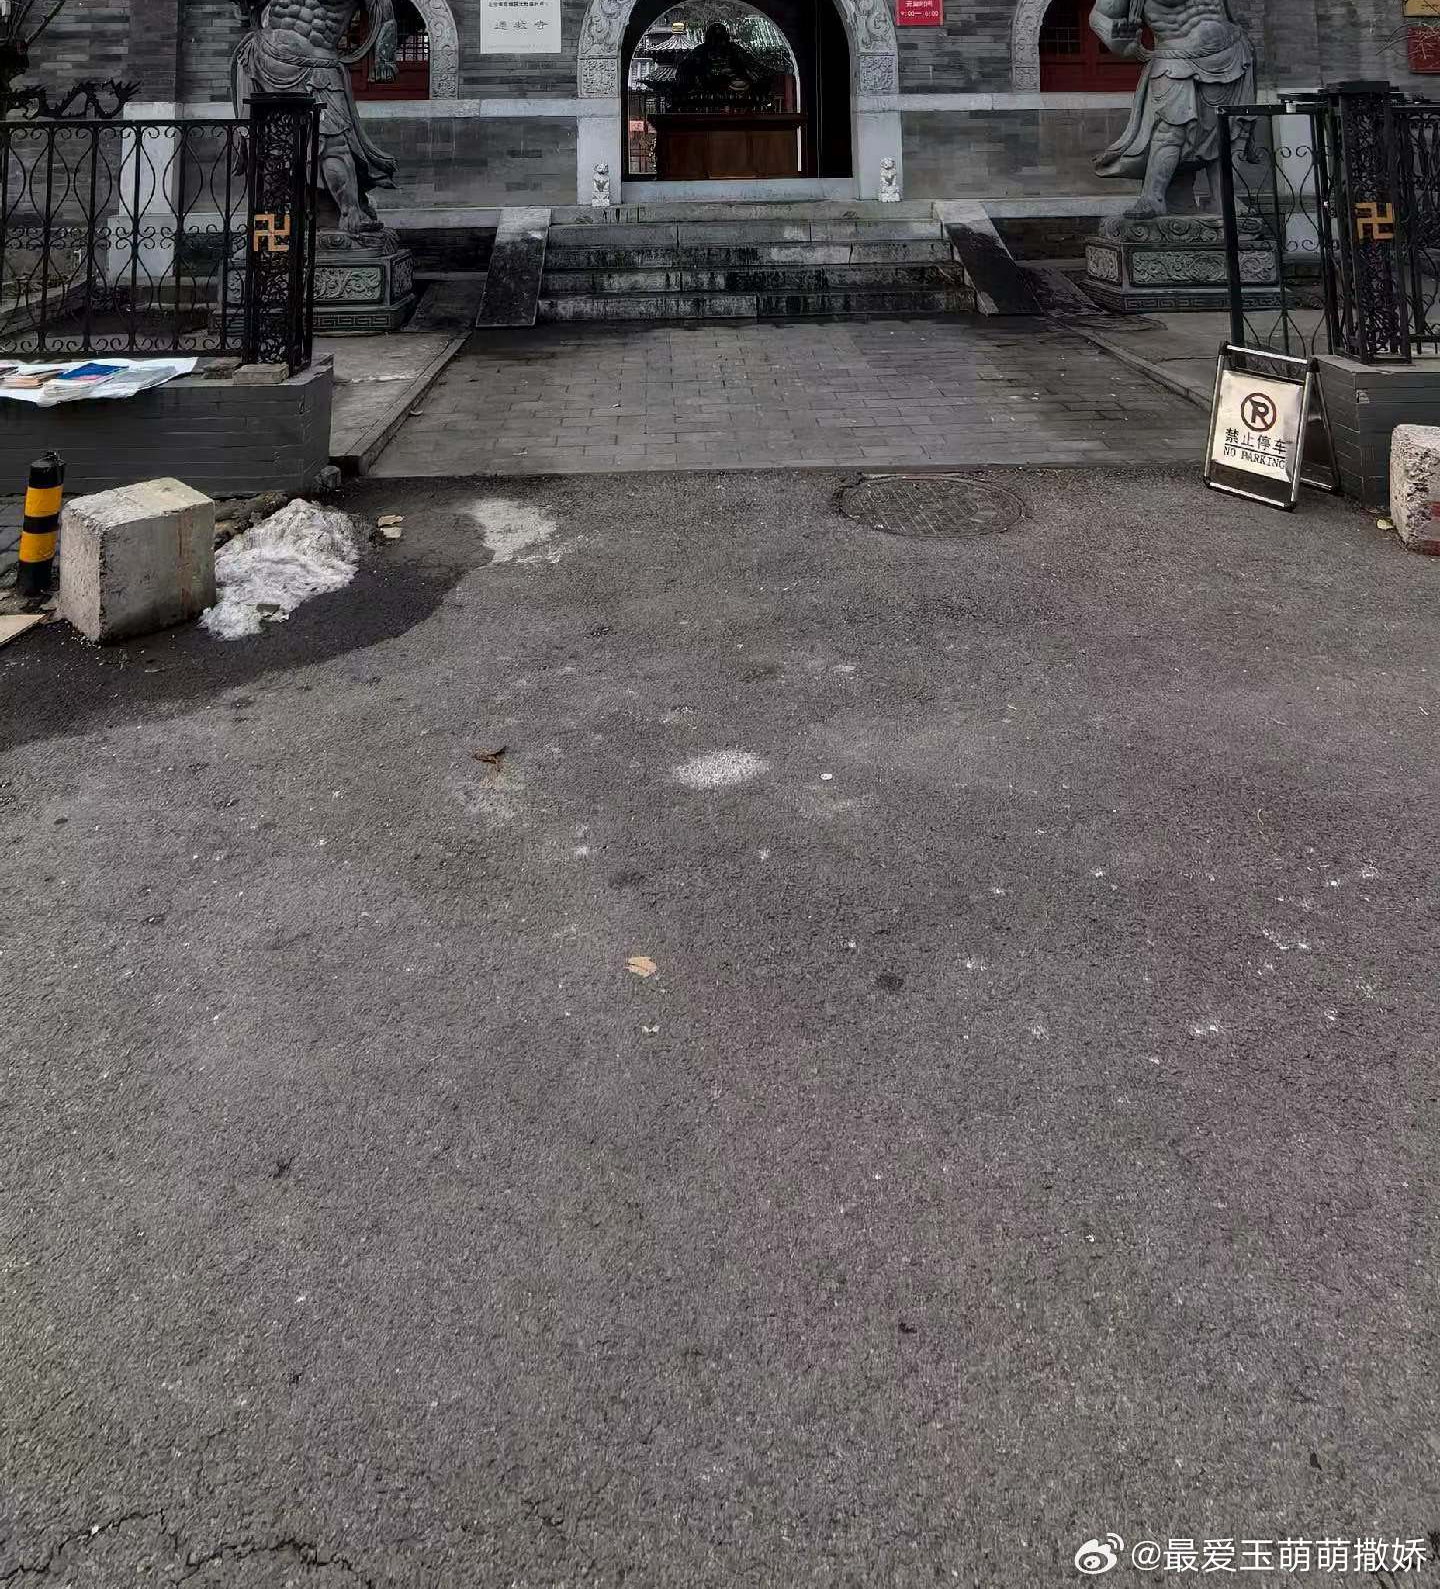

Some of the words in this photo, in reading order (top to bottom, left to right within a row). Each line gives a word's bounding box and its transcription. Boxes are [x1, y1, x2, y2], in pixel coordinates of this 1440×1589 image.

[1225, 427, 1287, 455] 禁止停车
[1223, 446, 1237, 457] NO
[1240, 450, 1286, 470] PARKING
